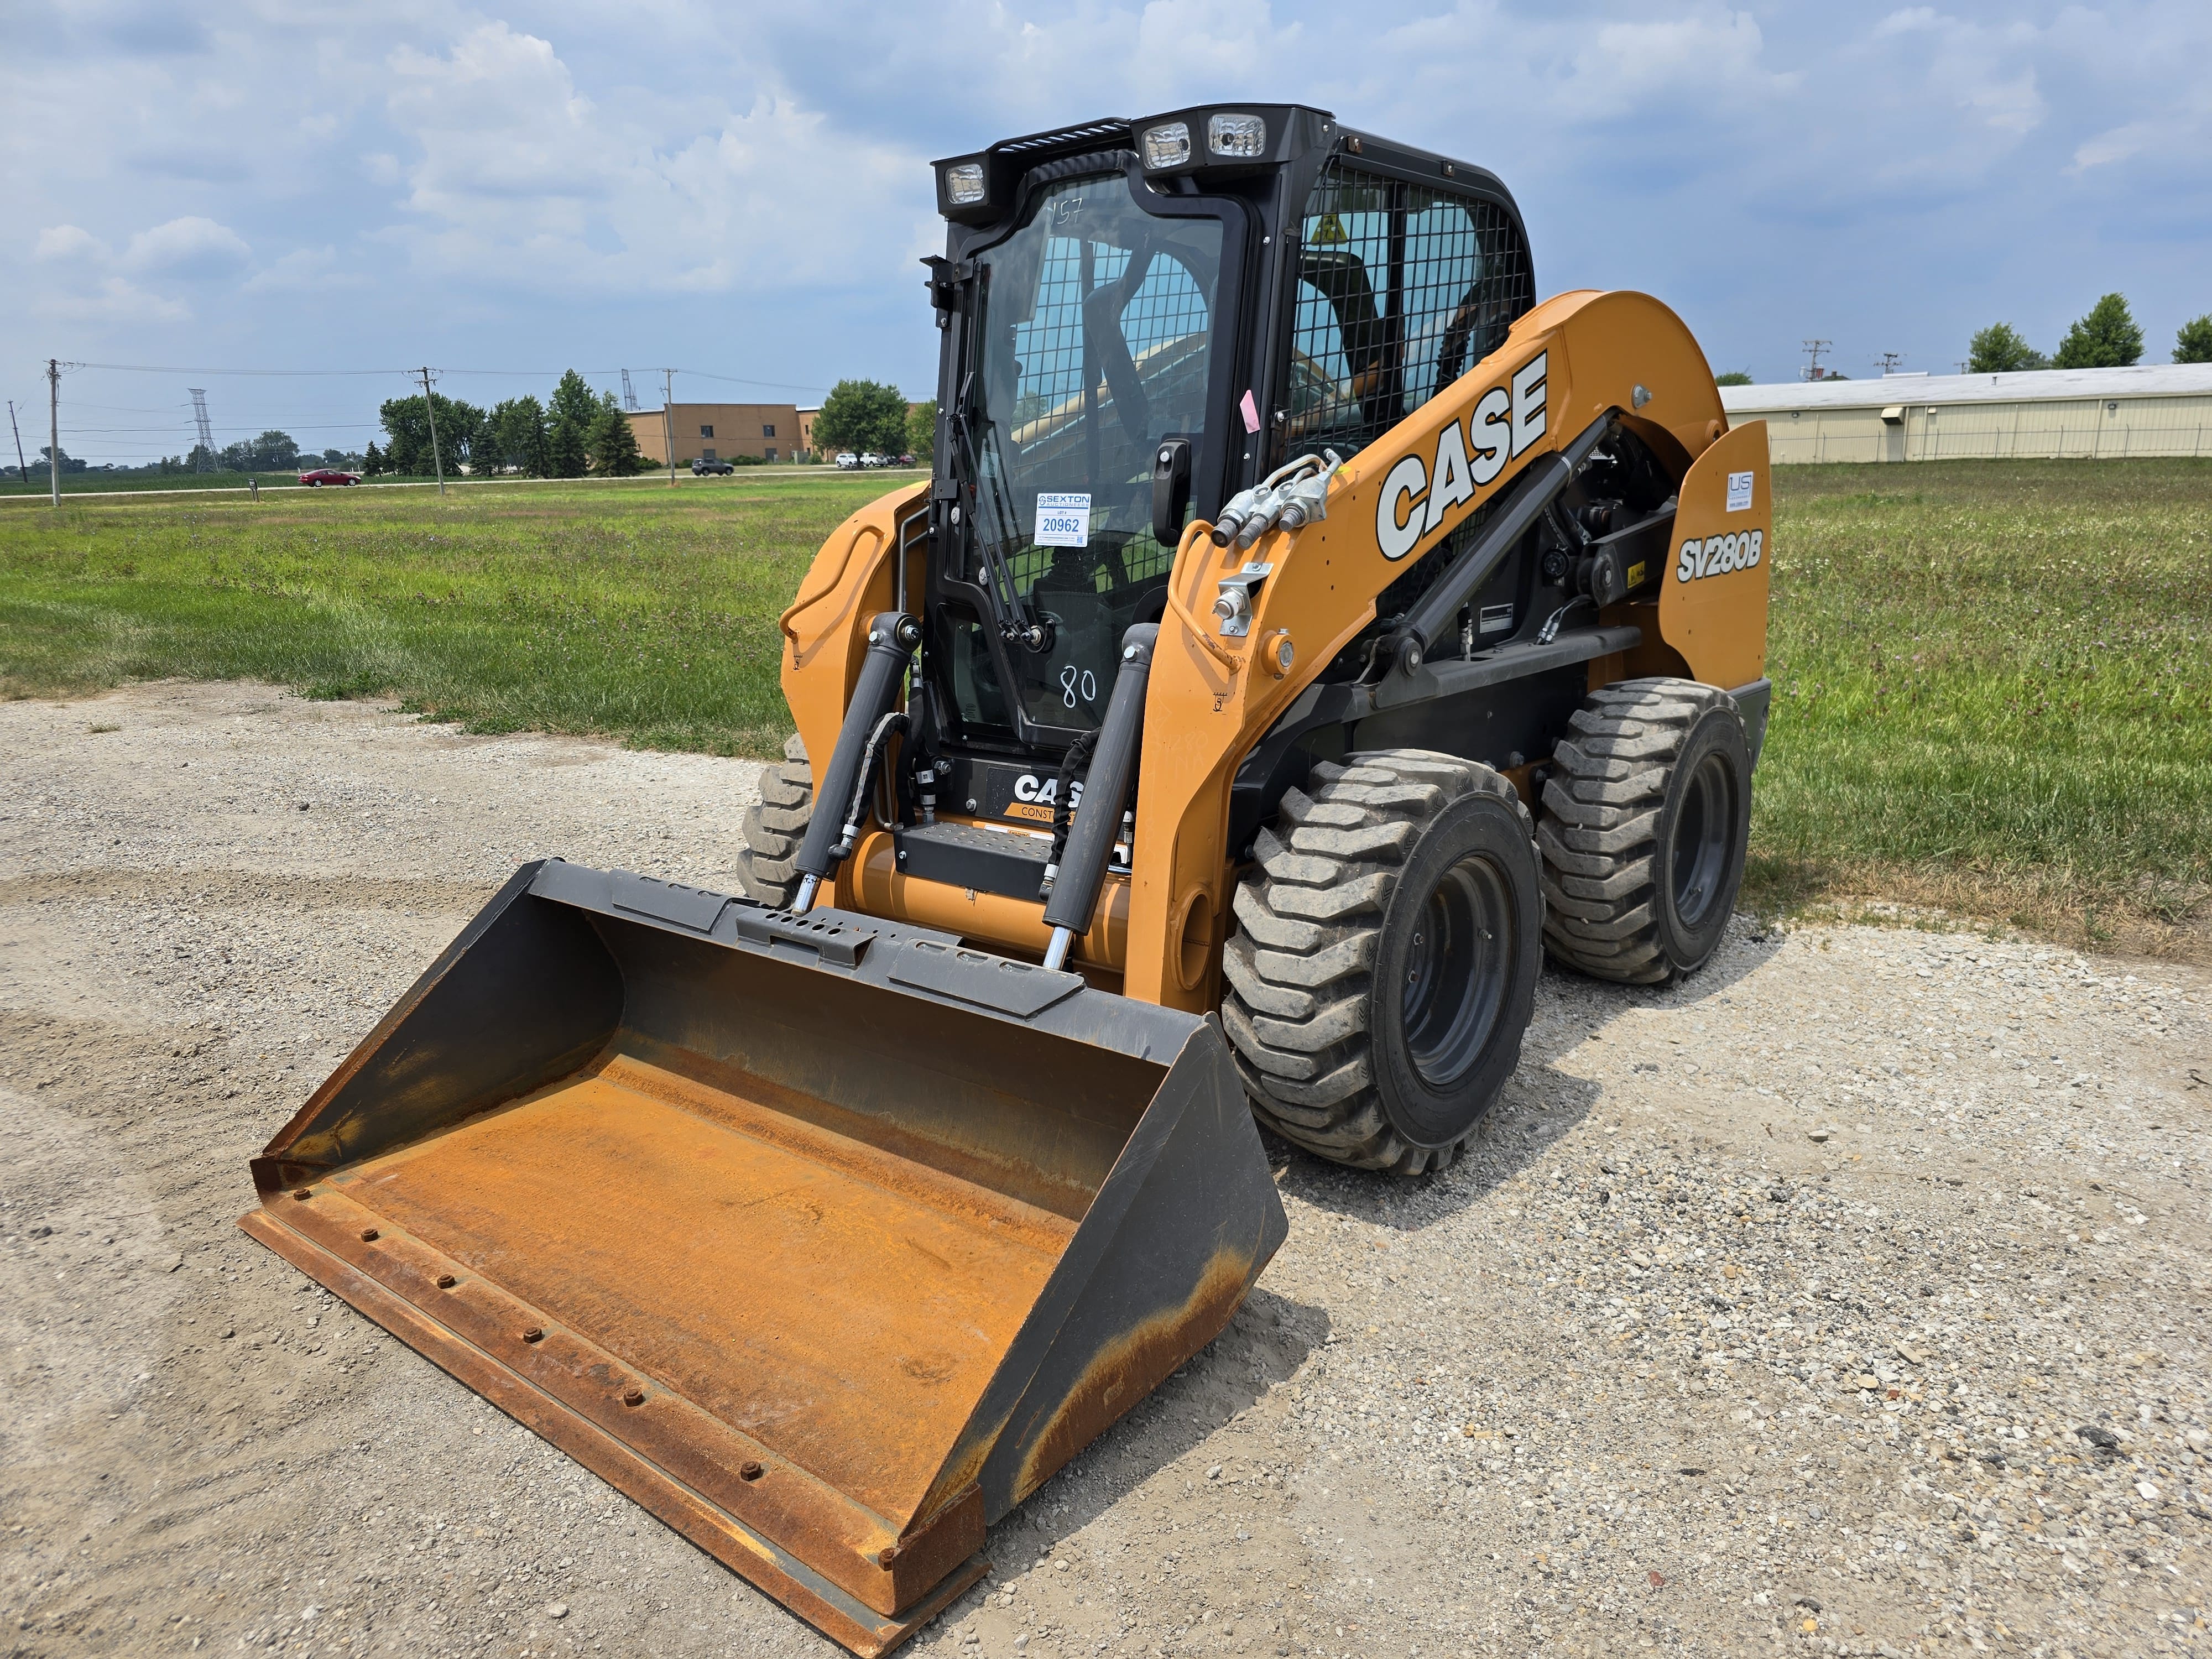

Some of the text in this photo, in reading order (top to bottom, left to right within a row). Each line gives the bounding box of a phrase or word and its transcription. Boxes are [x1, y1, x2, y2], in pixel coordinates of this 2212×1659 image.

[1051, 197, 1084, 225] 157
[1376, 348, 1548, 562] CASE
[1729, 475, 1752, 491] US
[1043, 519, 1079, 532] 20962
[1677, 529, 1763, 584] SV280B
[1060, 665, 1096, 708] 80
[1014, 774, 1084, 808] CAS
